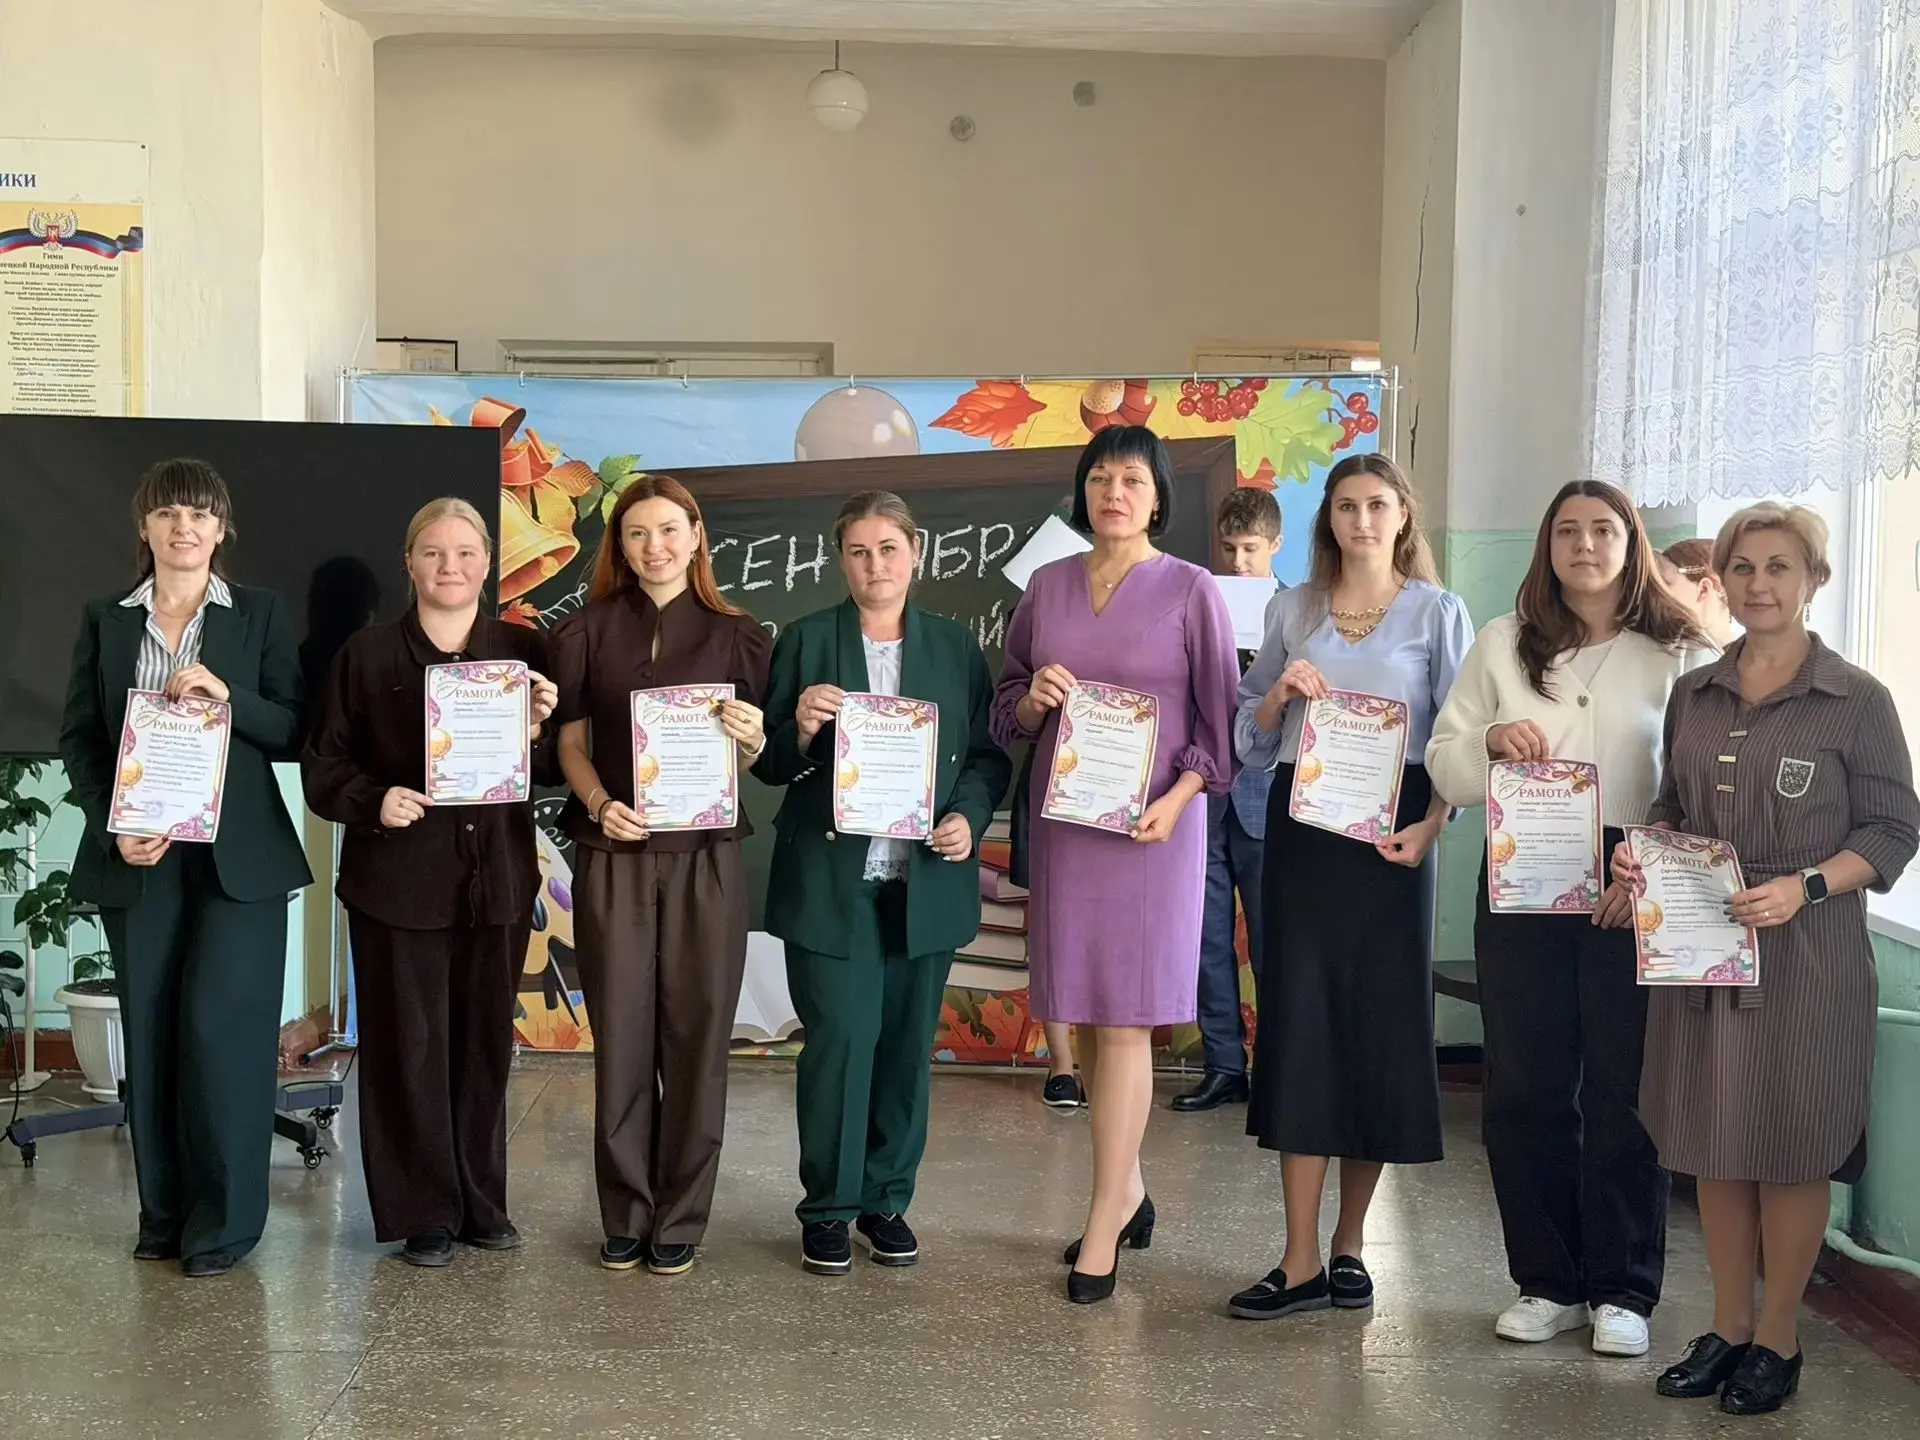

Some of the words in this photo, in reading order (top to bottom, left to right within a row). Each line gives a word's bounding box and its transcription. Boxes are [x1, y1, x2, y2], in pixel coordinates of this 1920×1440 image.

[43, 252, 63, 260] Гимн
[30, 262, 69, 270] Народной
[71, 263, 118, 272] Республики
[436, 681, 503, 699] ГРАМОТА
[134, 711, 202, 733] ГРАМОТА
[642, 706, 708, 725] ГРАМОТА
[846, 712, 911, 732] ГРАМОТА
[1071, 701, 1133, 725] ГРАМОТА
[1314, 708, 1382, 733] ГРАМОТА
[1498, 779, 1572, 800] ГРАМОТА
[1640, 845, 1711, 870] ГРАМОТА
